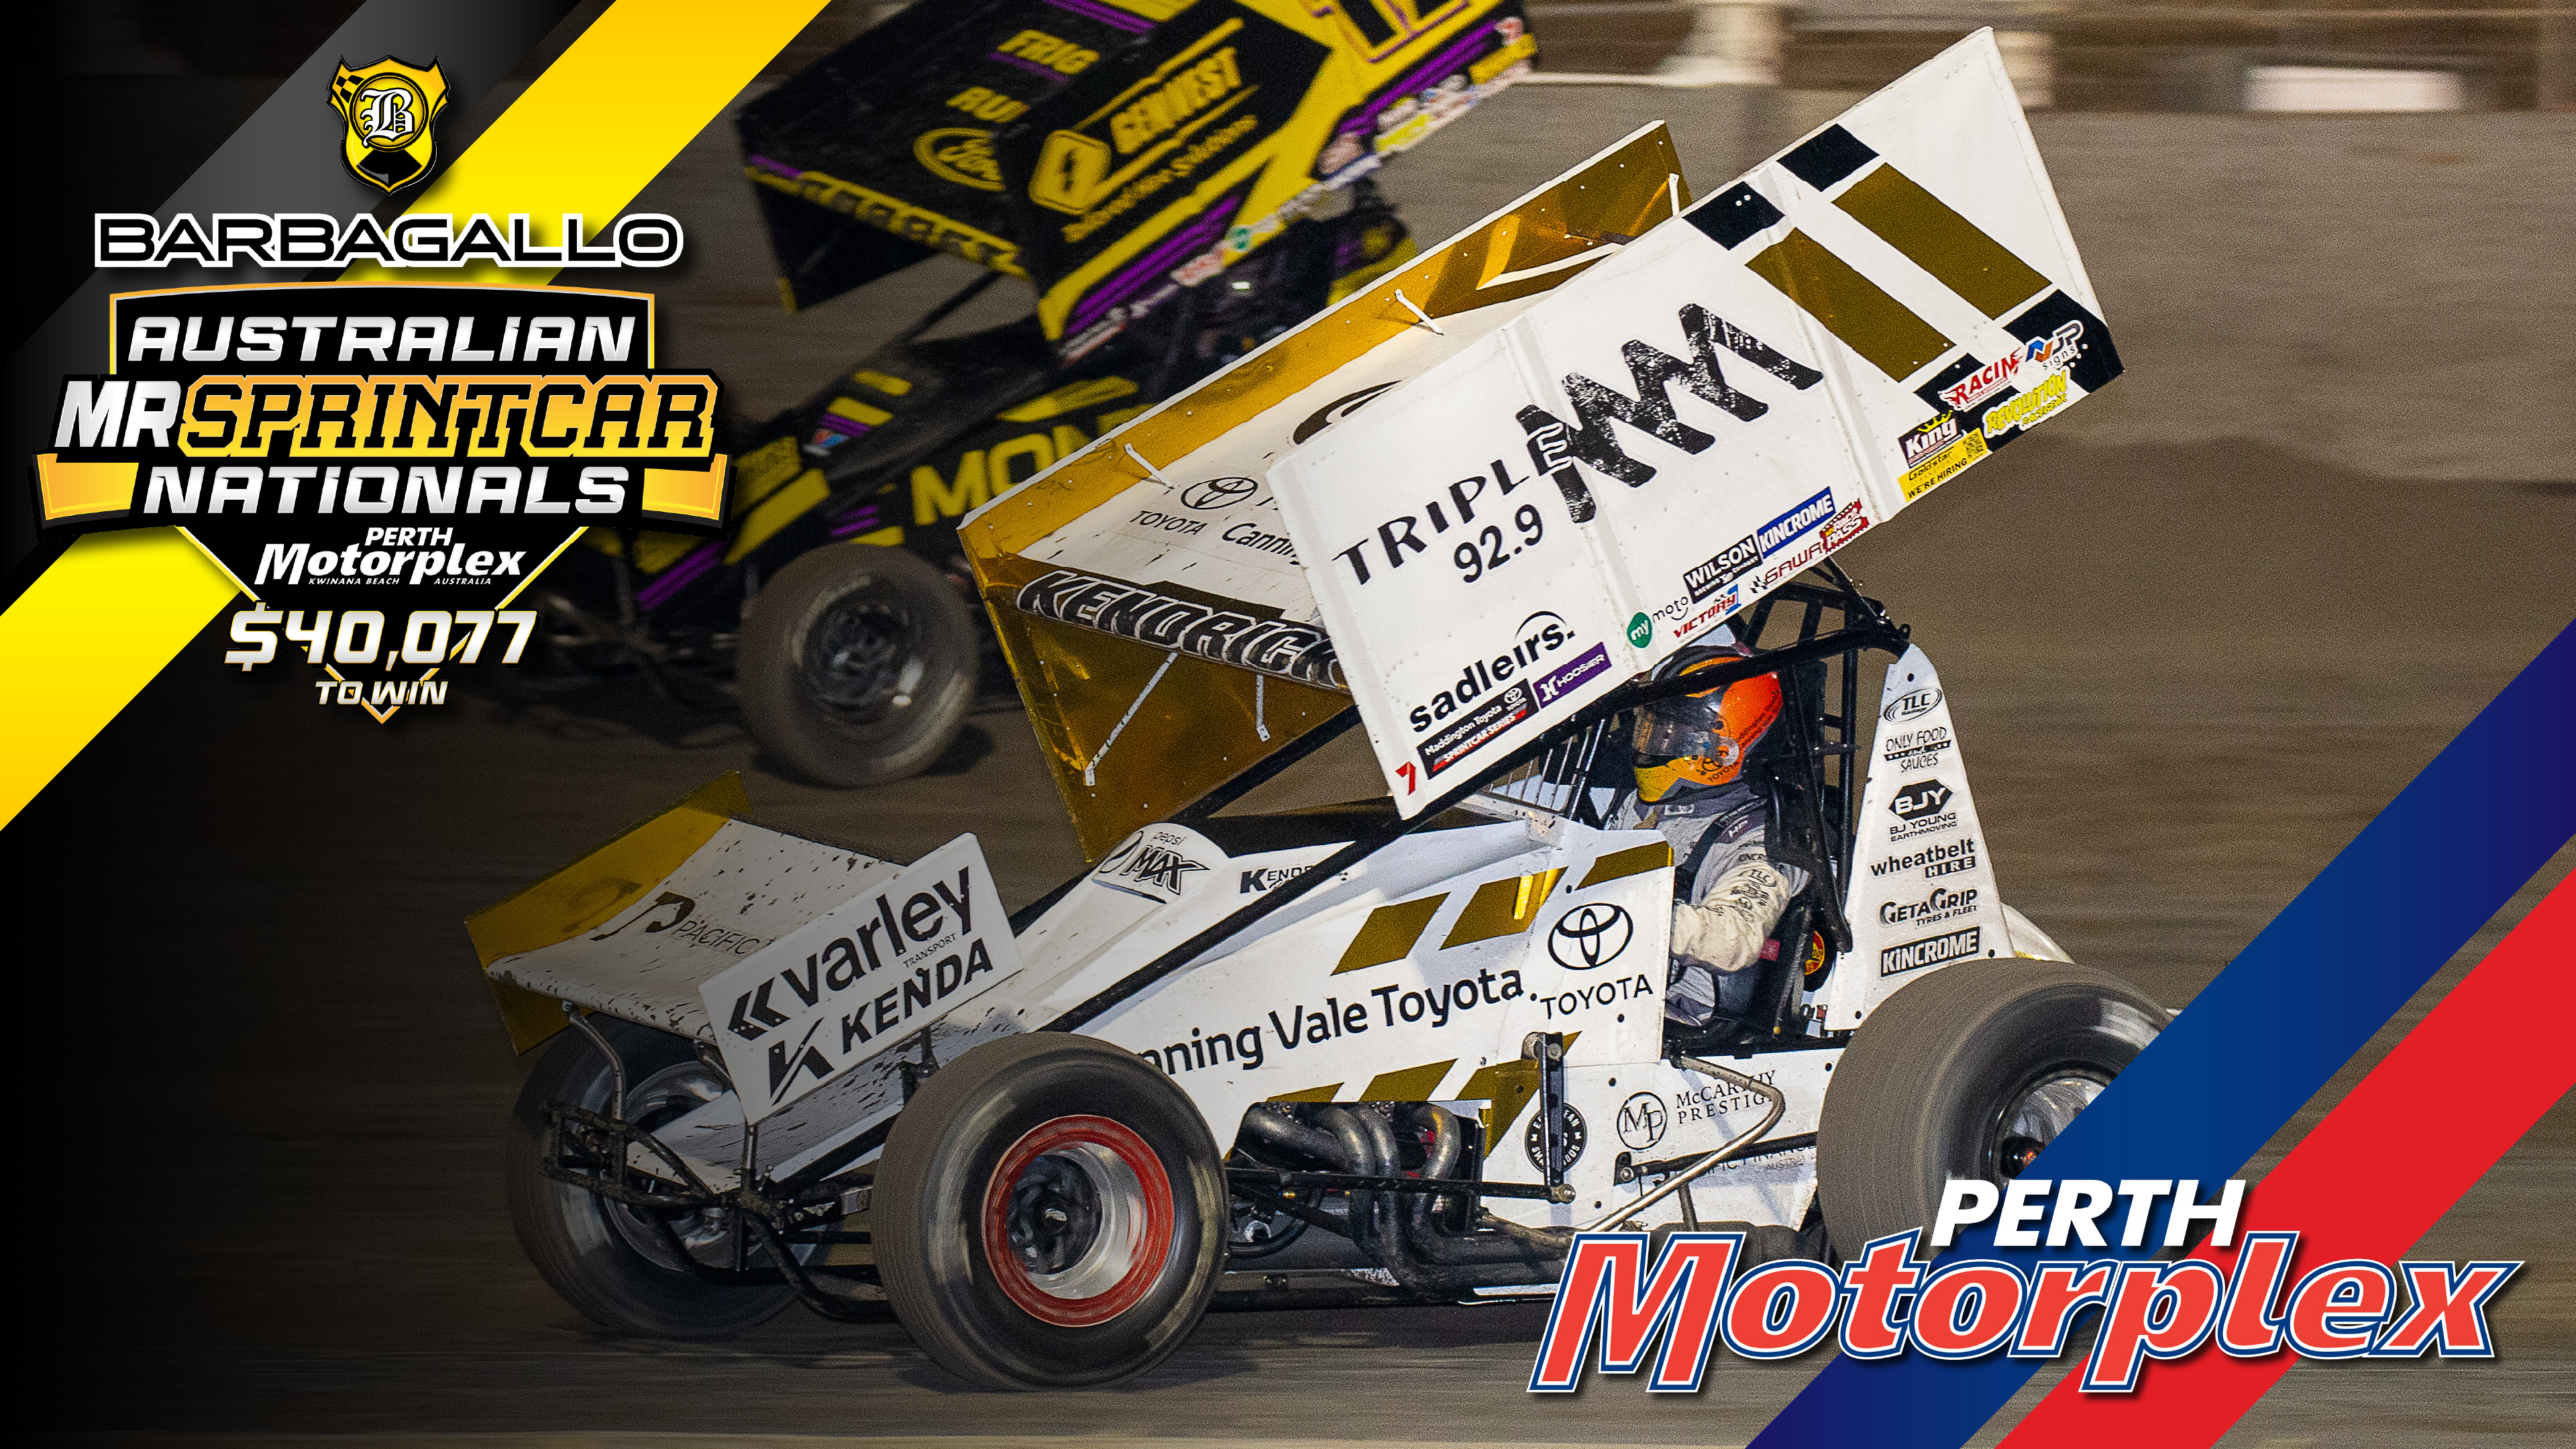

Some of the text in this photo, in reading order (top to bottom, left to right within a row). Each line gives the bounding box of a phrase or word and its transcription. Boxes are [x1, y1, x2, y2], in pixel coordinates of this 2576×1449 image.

[2043, 346, 2078, 370] signs
[1986, 370, 2067, 434] REVOLUTION
[1906, 419, 1957, 458] King
[1908, 458, 1967, 498] WE'RE HIRING
[1332, 421, 1574, 585] TRIPLE
[1130, 511, 1208, 535] TOYOTA
[1758, 494, 1833, 552] KINCROME
[1827, 518, 1862, 548] PASS
[1454, 504, 1545, 584] 92.9
[1684, 538, 1756, 588] WILSON
[1765, 542, 1822, 586] SAWA
[1631, 596, 1688, 641] my moto
[1556, 654, 1605, 688] HOOSIER
[1902, 694, 1931, 710] TLC
[1424, 705, 1503, 755] Maddington Toyota
[1444, 713, 1515, 762] SPRINTCAR SERIES
[1886, 727, 1947, 751] ONLY FOOD
[1900, 753, 1938, 773] SAUCES
[1895, 788, 1946, 814] BJY
[1152, 831, 1186, 846] pepsi
[1890, 812, 1956, 835] BJ YOUNG
[1891, 821, 1957, 842] EARTHMOVING
[1870, 839, 1974, 876] wheatbelt
[1927, 857, 1973, 877] HIRE
[1917, 913, 1942, 926] TYRES
[1953, 905, 1978, 916] FLEET
[671, 920, 760, 955] PACIFIC
[780, 866, 972, 1008] varley
[902, 933, 957, 969] TRANSPORT
[1882, 930, 1978, 973] KINCROME
[841, 937, 994, 1055] KENDA
[1540, 973, 1654, 1020] TOYOTA
[1268, 997, 1368, 1050] Vale
[1678, 1092, 1772, 1124] PRESTIG
